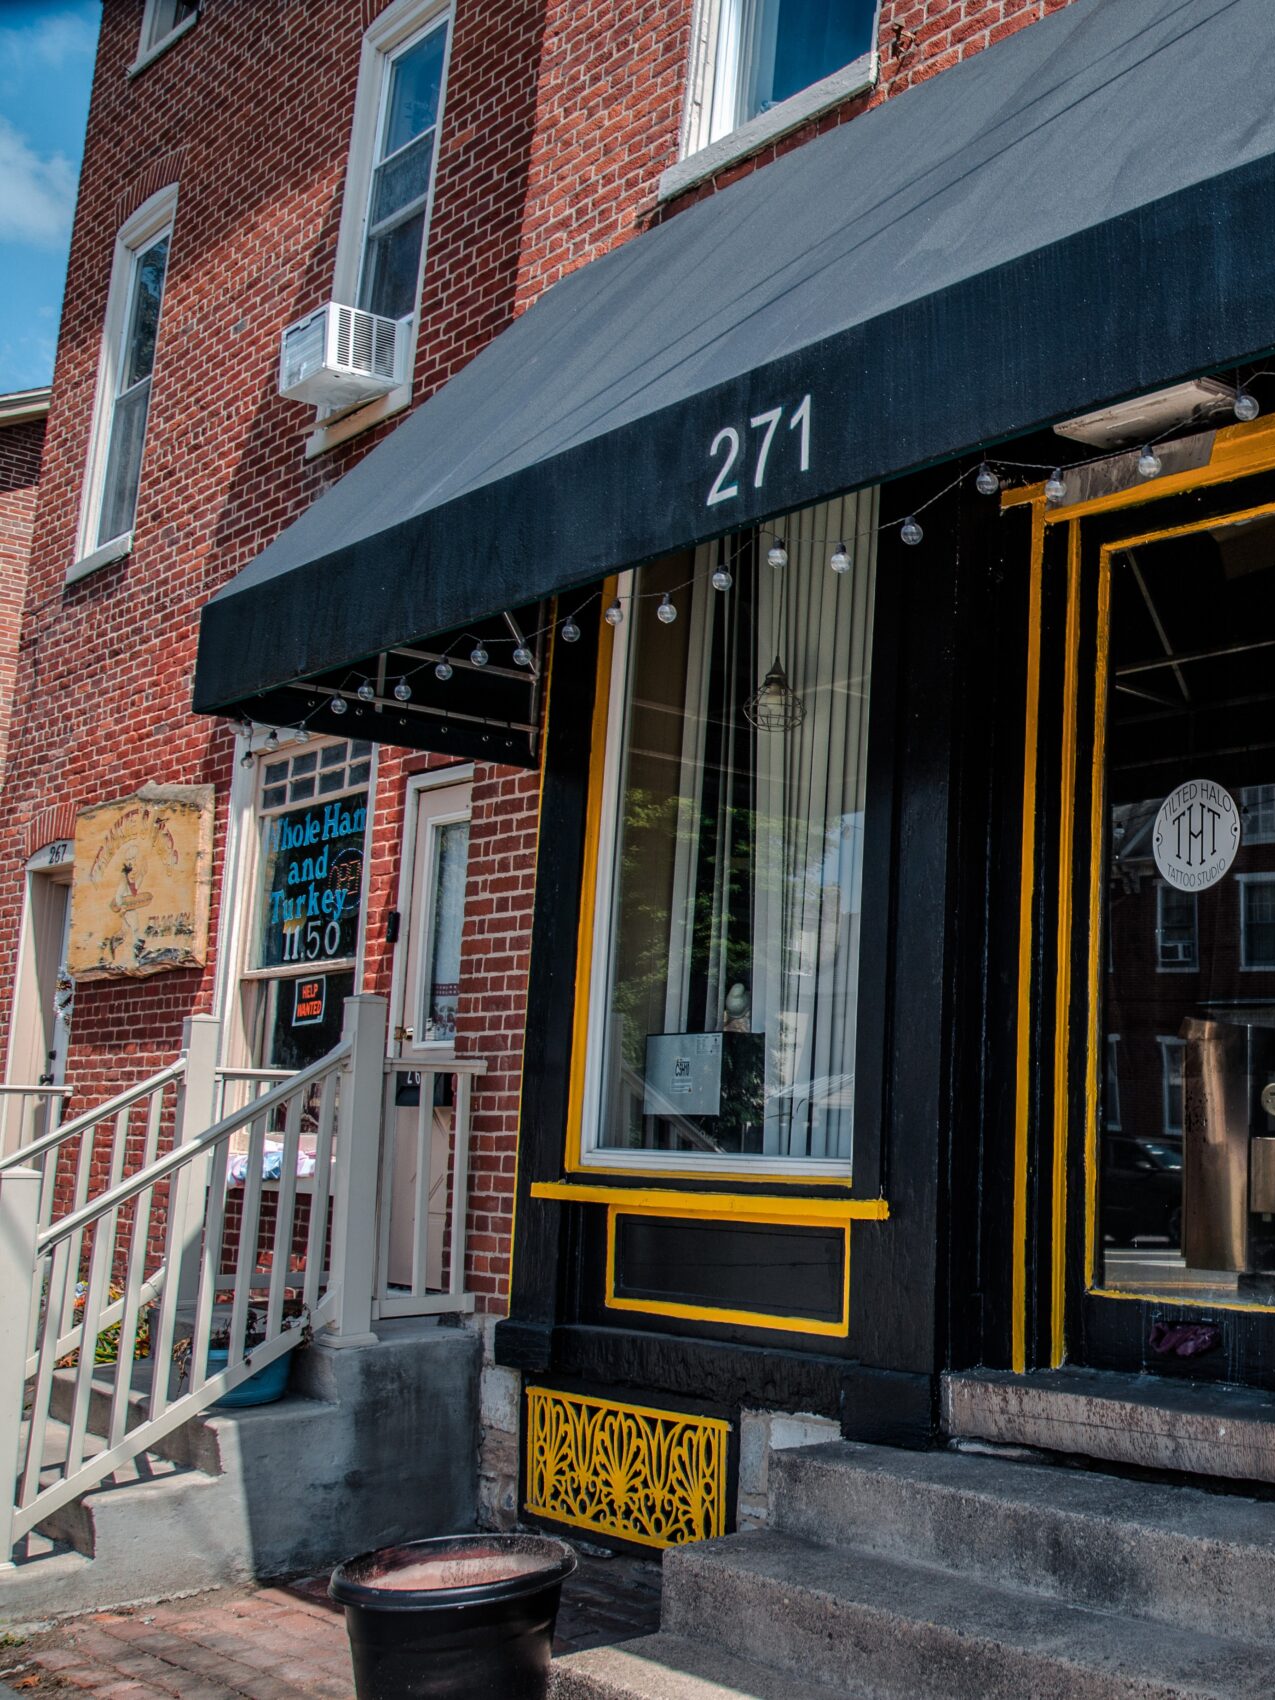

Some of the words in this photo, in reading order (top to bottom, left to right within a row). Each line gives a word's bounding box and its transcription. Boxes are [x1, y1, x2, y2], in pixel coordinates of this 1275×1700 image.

[706, 394, 811, 506] 271
[1162, 783, 1198, 820] TILTED
[1201, 782, 1232, 813] HALO
[48, 843, 68, 865] 267
[287, 844, 328, 885] and
[1167, 863, 1196, 888] TATTOO
[1197, 858, 1227, 887] STUDIO
[270, 881, 348, 925] Turkey
[282, 920, 341, 961] 11.50
[296, 1000, 322, 1018] WANTED
[302, 983, 319, 1000] HELP
